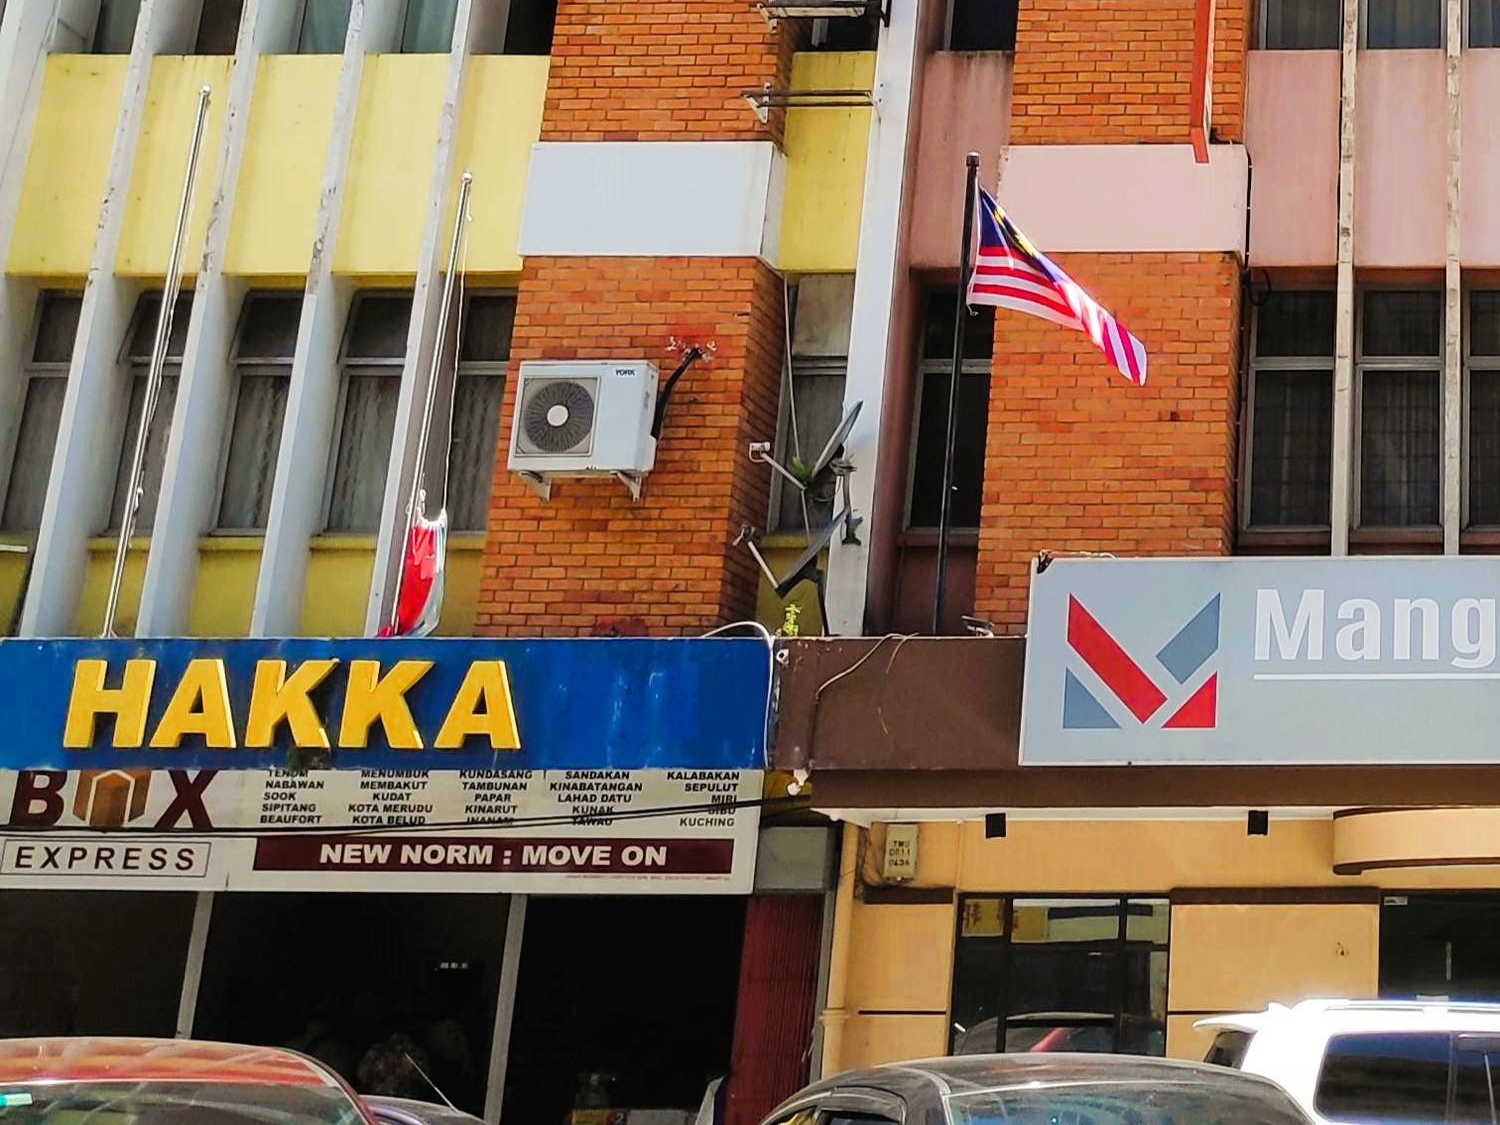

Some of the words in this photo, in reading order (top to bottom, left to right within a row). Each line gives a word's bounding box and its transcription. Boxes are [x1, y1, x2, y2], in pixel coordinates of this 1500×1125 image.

[62, 658, 521, 750] HAKKA
[459, 769, 533, 780] KUNDASANG
[565, 771, 630, 780] SANDAKAN
[667, 771, 740, 781] KALABAKAN
[265, 780, 324, 789] NABAWAN
[360, 781, 428, 790] MEMBAKUT
[462, 781, 527, 791] TAMBUNAN
[549, 782, 643, 792] KINABATANGAN
[684, 783, 739, 792] SEPULUT
[263, 792, 297, 801] SOOK
[372, 792, 412, 801] KUDAT
[474, 793, 512, 803] PAPAR
[557, 794, 597, 803] LAHAD
[600, 794, 632, 803] DATU
[711, 794, 737, 804] MIRI
[262, 803, 317, 813] SIPITANG
[348, 803, 380, 813] KOTA
[382, 803, 433, 813] MERUDU
[464, 805, 518, 814] KINARUT
[572, 805, 614, 815] KUNAK
[260, 814, 323, 824] BEAUFORT
[352, 815, 383, 824] KOTA
[386, 816, 427, 825] BELUD
[679, 817, 735, 827] KUCHING
[14, 845, 195, 871] EXPRESS
[319, 843, 392, 864] NEW
[400, 844, 494, 865] NORM
[522, 845, 612, 866] MOVE
[621, 845, 668, 867] ON
